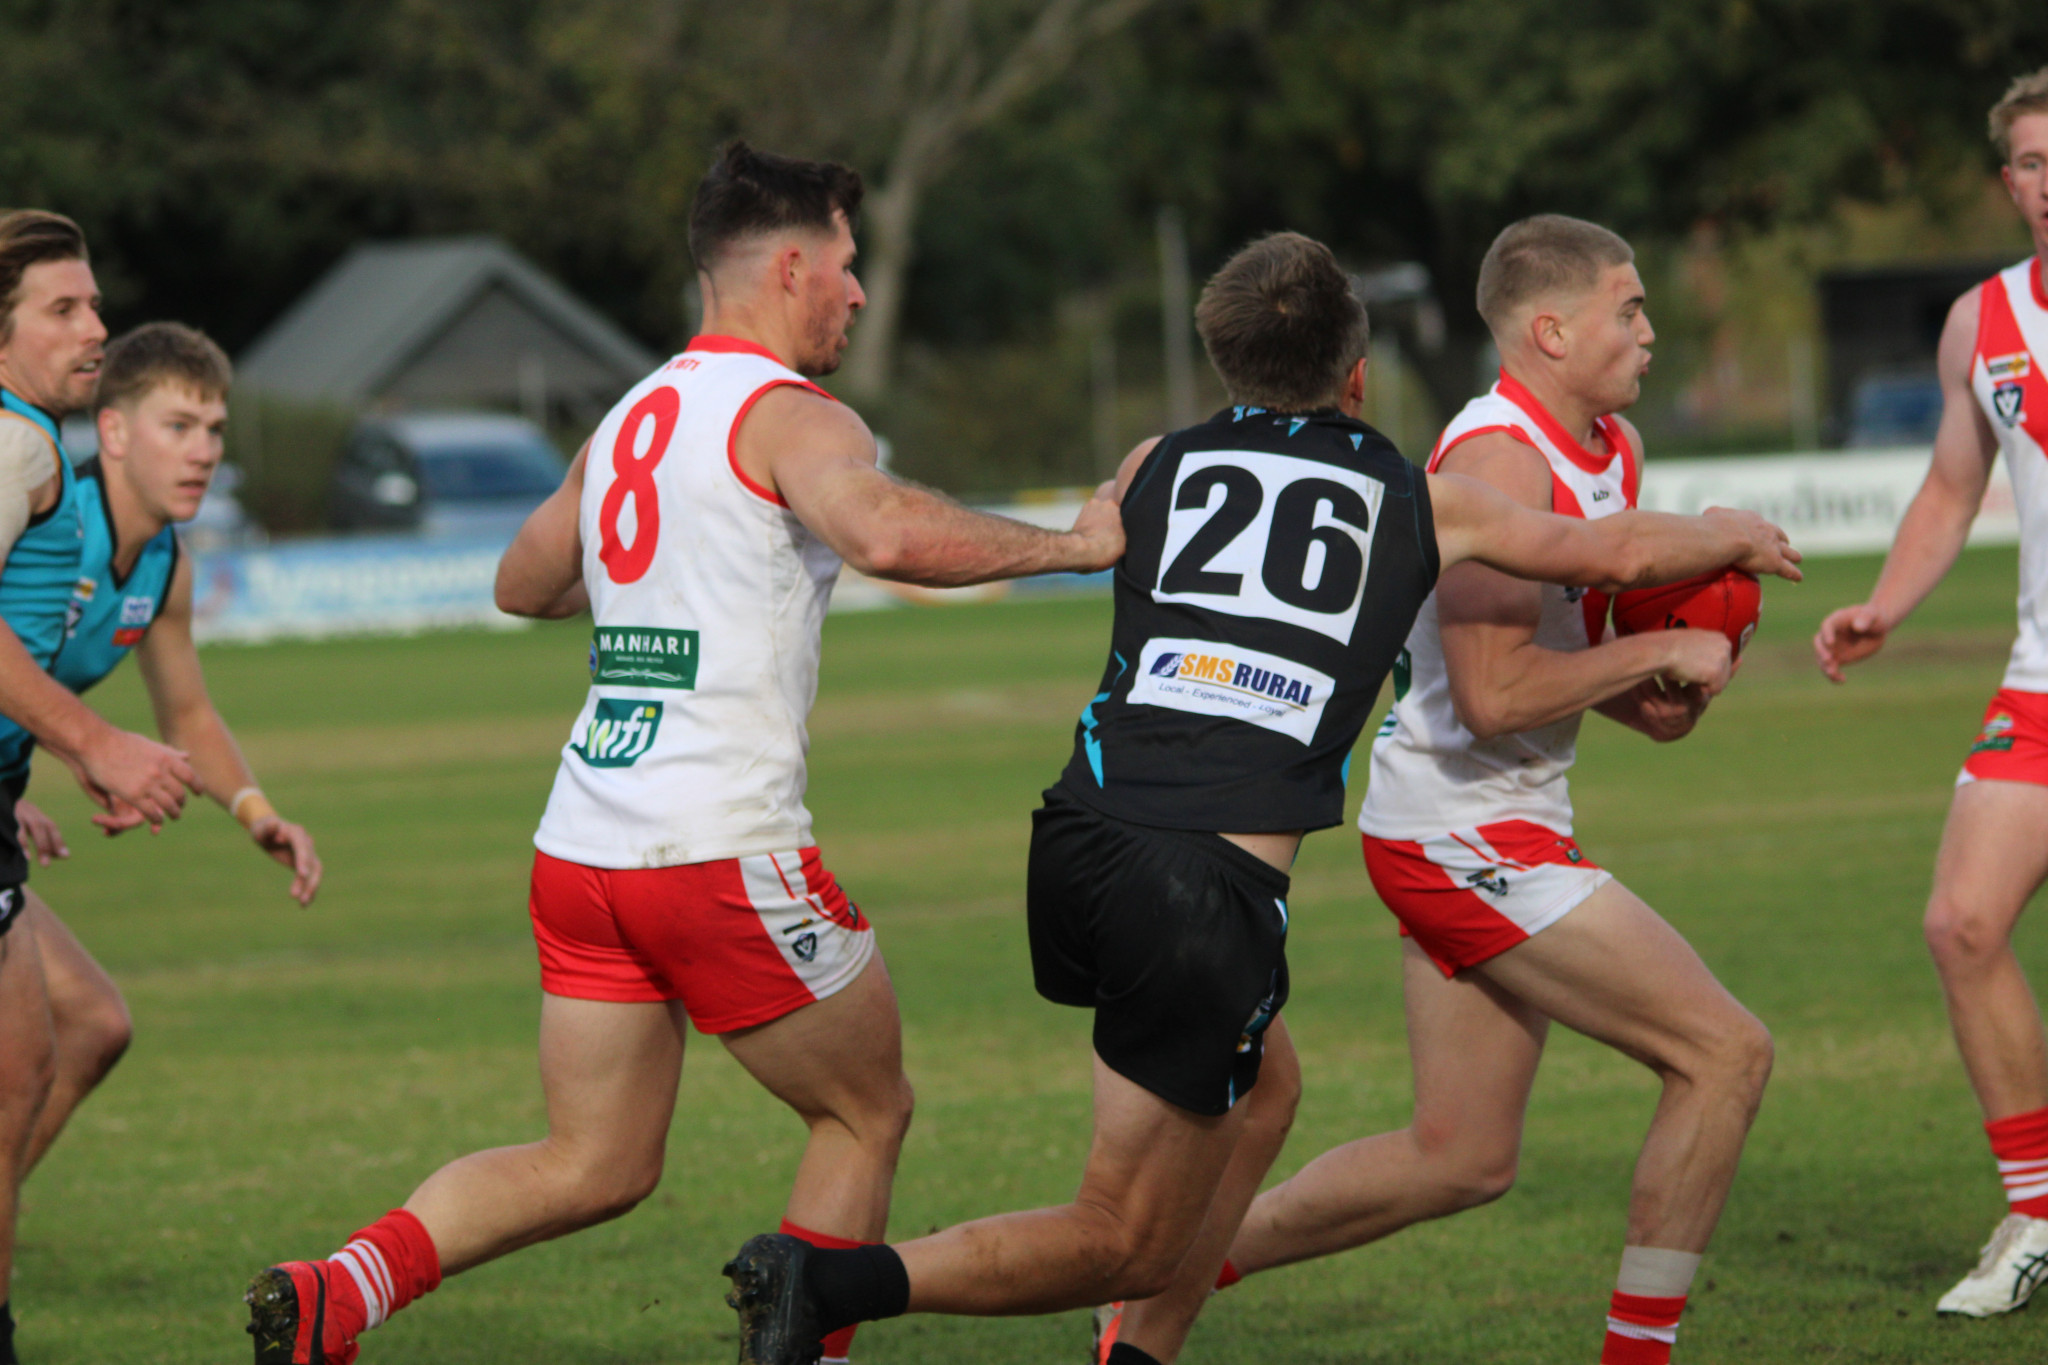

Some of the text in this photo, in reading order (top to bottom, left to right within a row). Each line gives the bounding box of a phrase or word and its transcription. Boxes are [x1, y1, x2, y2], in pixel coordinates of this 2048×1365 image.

[599, 385, 681, 585] 8
[1159, 464, 1370, 615] 26
[600, 633, 690, 656] MANHARI
[1158, 682, 1185, 696] Local
[1192, 688, 1252, 709] Experienced
